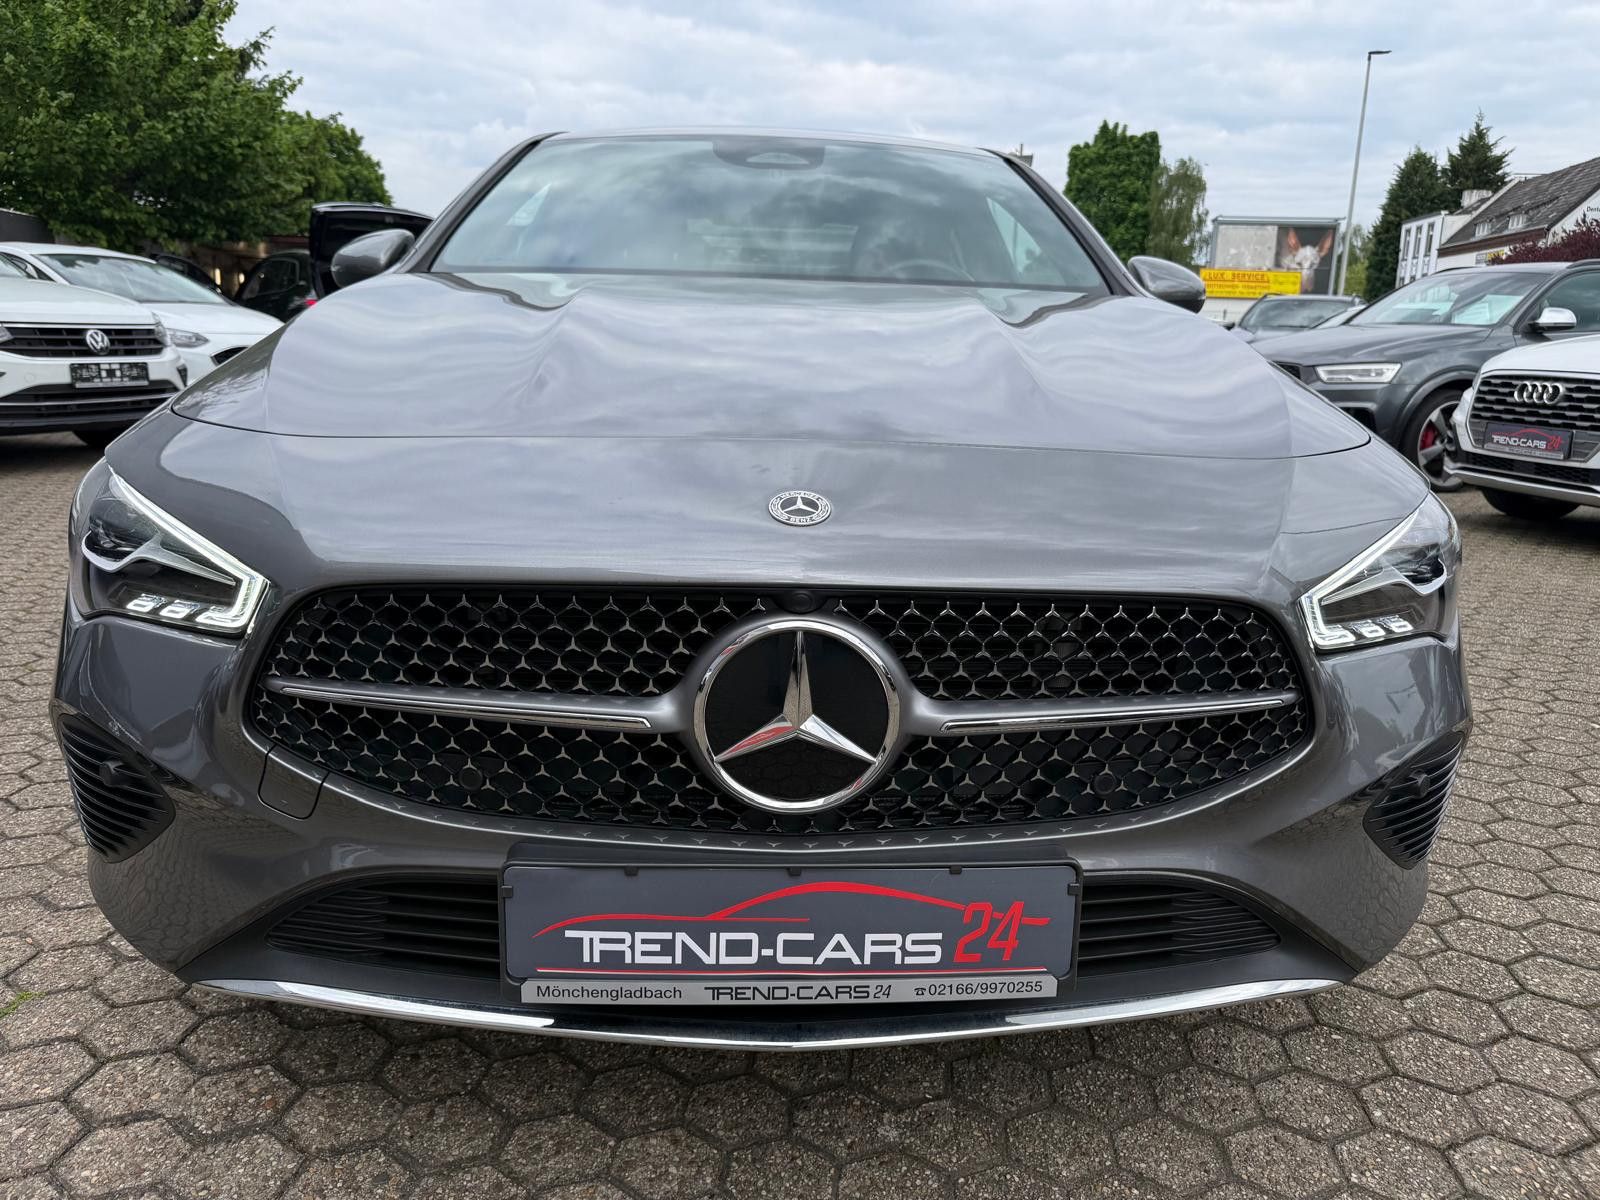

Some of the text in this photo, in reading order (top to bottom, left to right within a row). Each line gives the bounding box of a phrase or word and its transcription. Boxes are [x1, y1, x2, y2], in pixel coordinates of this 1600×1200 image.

[1231, 271, 1265, 281] SERVICE
[564, 901, 1025, 965] TREND-CARS 24
[536, 985, 682, 1002] Mönchengladbach
[704, 985, 870, 1001] TREND-CARS
[873, 984, 892, 999] 24
